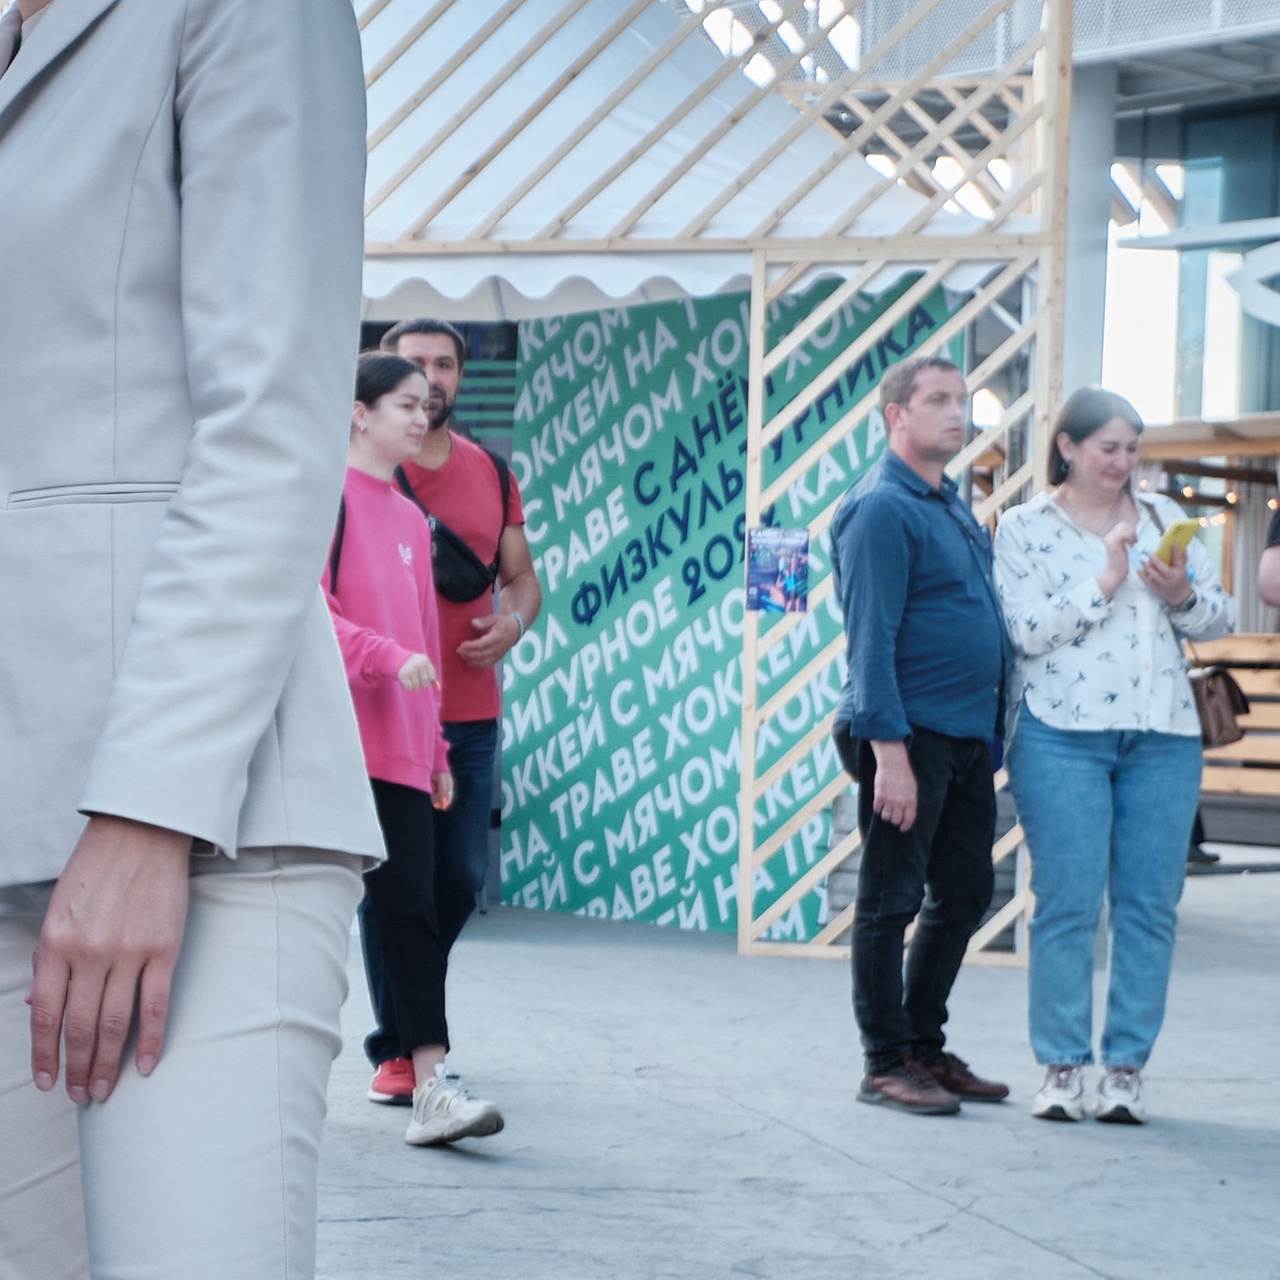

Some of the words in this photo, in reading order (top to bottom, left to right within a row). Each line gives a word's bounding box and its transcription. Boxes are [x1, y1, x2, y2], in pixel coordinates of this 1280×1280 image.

[623, 316, 678, 389] НА
[523, 499, 549, 543] С
[552, 369, 683, 522] МЯЧОМ
[633, 461, 661, 505] С
[610, 679, 639, 727] С
[642, 587, 765, 707] МЯЧО
[500, 820, 550, 883] НА
[549, 726, 658, 841] ТРАВЕ
[573, 840, 600, 885] С
[604, 726, 743, 867] МЯЧОМ
[574, 844, 677, 920] РАВЕ
